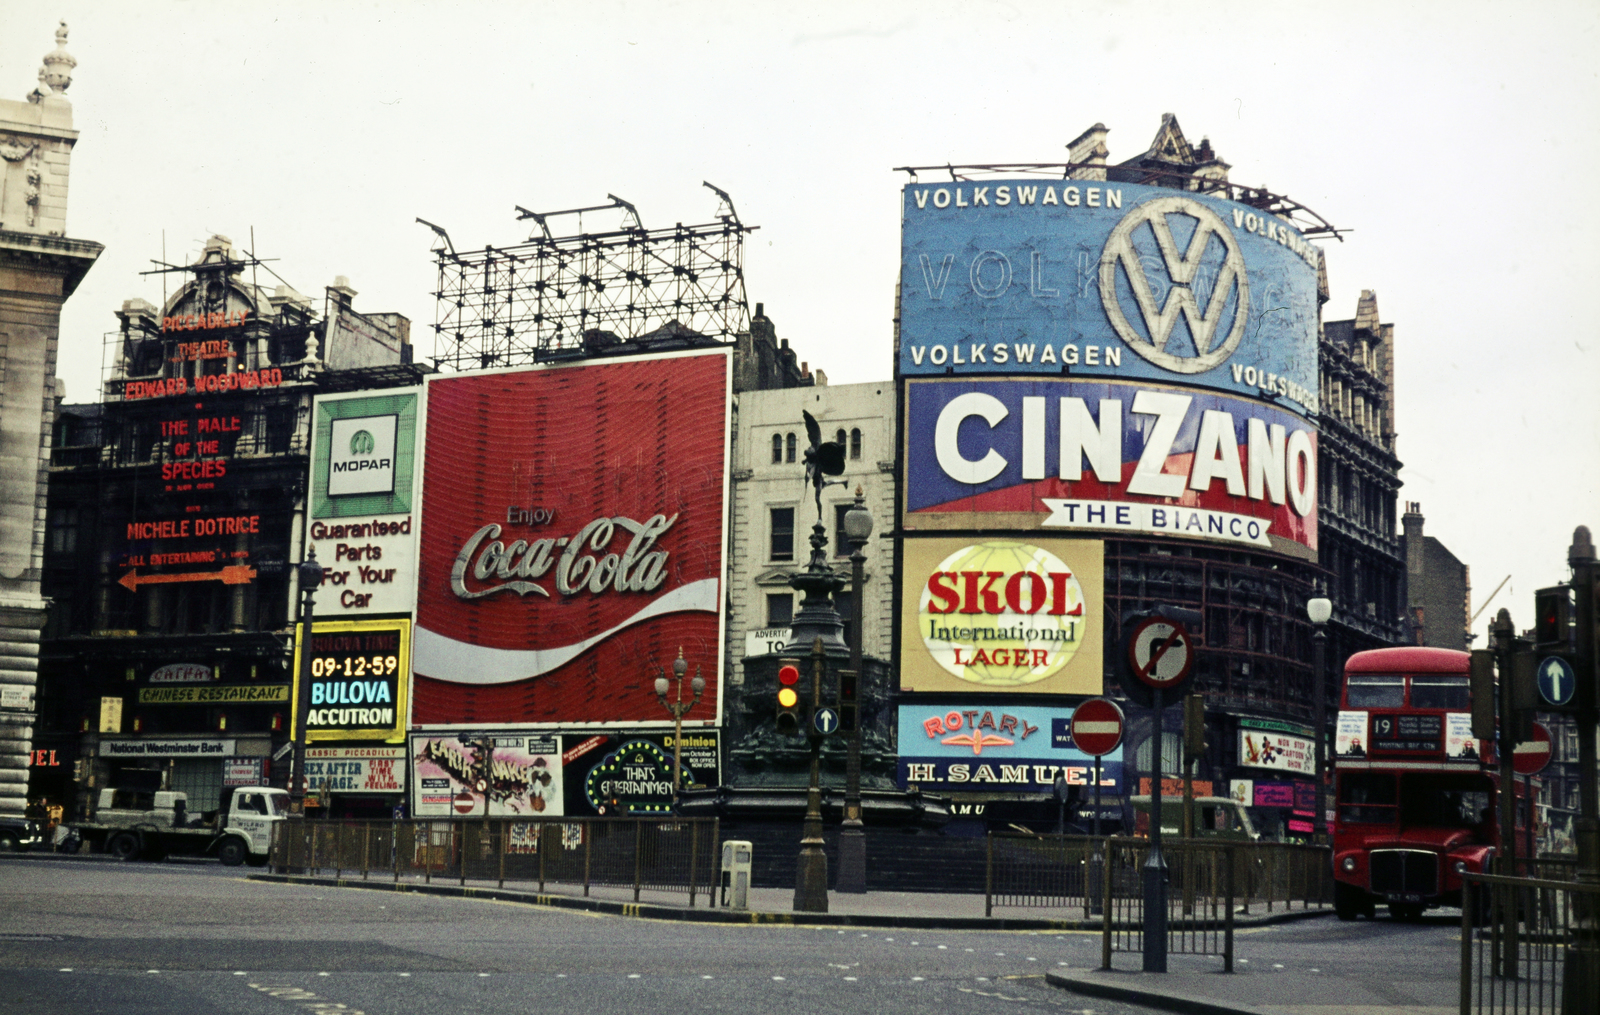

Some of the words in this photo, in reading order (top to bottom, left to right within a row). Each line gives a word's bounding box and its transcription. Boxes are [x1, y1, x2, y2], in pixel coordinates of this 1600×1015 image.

[914, 186, 1123, 209] VOLKSWAGEN
[162, 310, 248, 333] PICCADILLY
[178, 340, 229, 356] THEATRE
[911, 344, 1122, 367] VOLKSWAGEN
[125, 377, 187, 399] EDWARD
[194, 368, 282, 393] WOODWARD
[160, 420, 188, 436] THE
[197, 416, 241, 433] MALE
[175, 442, 190, 456] OF
[196, 440, 219, 454] THE
[934, 390, 1315, 517] CINZANO
[161, 460, 226, 480] SPECIES
[333, 458, 391, 473] MOPAR
[506, 506, 555, 525] Enjoy
[1064, 503, 1131, 525] THE
[1152, 509, 1260, 539] BIANCO
[127, 520, 190, 540] MICHELE
[195, 516, 260, 536] DOTRICE
[310, 516, 412, 541] Guaranteed
[336, 544, 382, 562] Parts
[451, 512, 679, 599] Coca-Cola
[321, 567, 350, 586] For
[358, 565, 396, 584] Your
[340, 589, 372, 609] Car
[928, 571, 1082, 615] SKOL
[930, 619, 1075, 642] International
[311, 635, 361, 651] BULOVA
[365, 635, 398, 651] TIME
[766, 641, 785, 653] TO
[954, 648, 1049, 666] LAGER
[154, 667, 211, 680] CATHAY
[143, 687, 194, 701] CHINESE
[201, 685, 283, 700] RESTAURANT
[311, 681, 391, 704] BULOVA
[307, 708, 393, 725] ACCUTRON
[923, 710, 1038, 739] ROTARY
[1374, 720, 1390, 734] 19
[110, 743, 145, 753] National
[147, 742, 200, 752] Westminster
[201, 742, 223, 752] Bank
[1278, 738, 1290, 747] NON
[307, 749, 338, 757] LASSIC
[345, 749, 397, 757] PICCADILLY
[303, 763, 323, 775] SEX
[326, 763, 361, 775] AFTER
[369, 760, 395, 768] FIRST
[370, 767, 391, 775] TIME
[368, 774, 394, 782] WITH
[623, 766, 656, 781] THAT'S
[365, 781, 397, 790] FEELING
